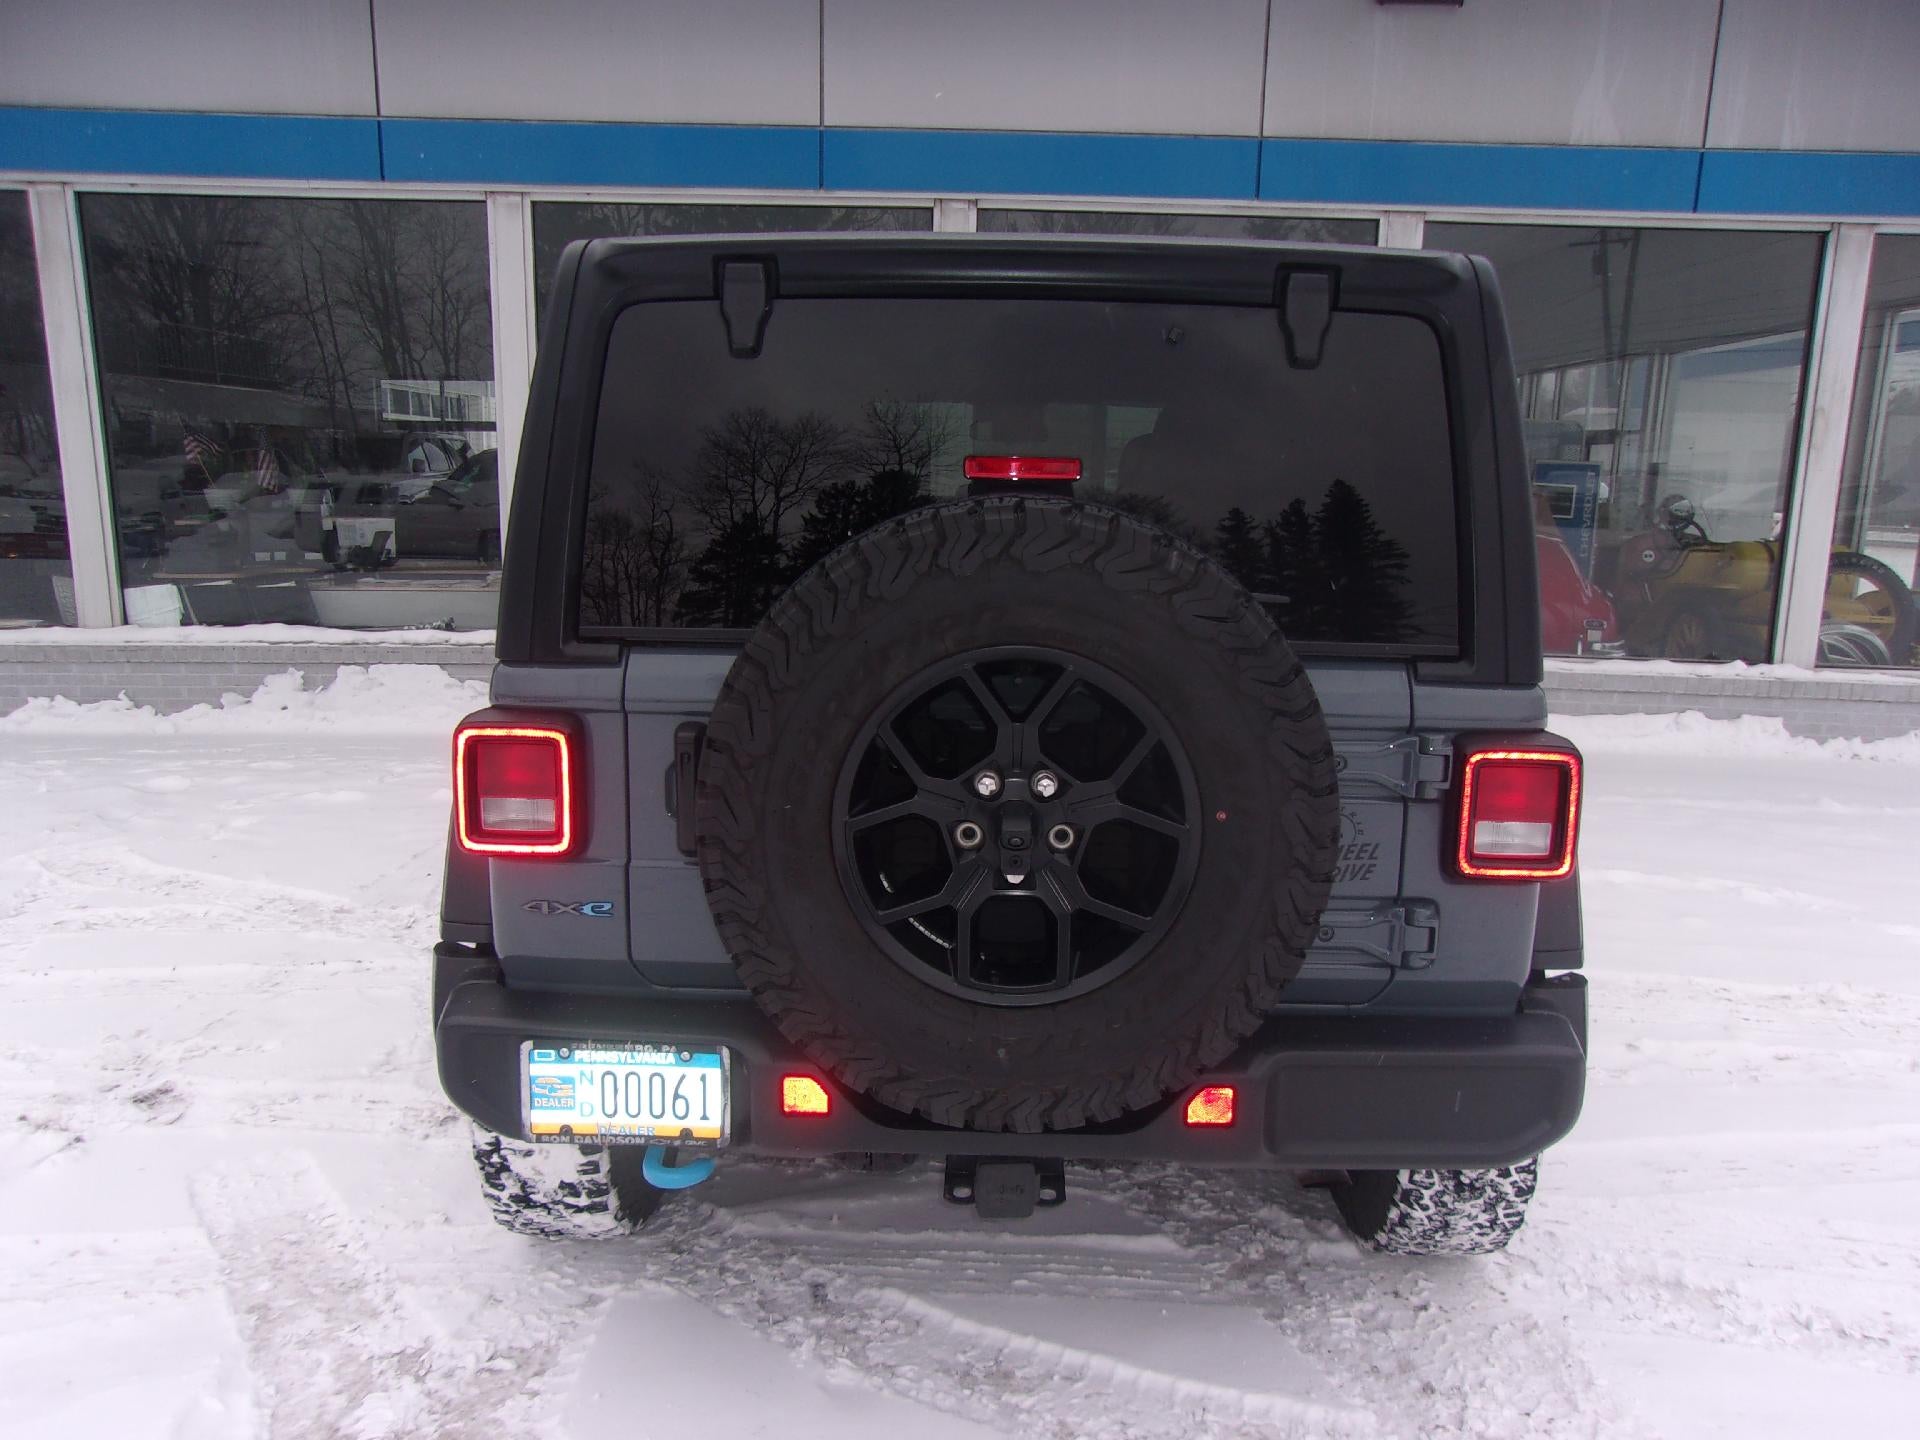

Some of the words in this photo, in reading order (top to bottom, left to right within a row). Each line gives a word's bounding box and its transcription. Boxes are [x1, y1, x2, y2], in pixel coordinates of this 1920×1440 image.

[574, 1050, 676, 1065] PENNSYLVANIA
[600, 1070, 710, 1121] 00061
[534, 1097, 574, 1108] DEALER
[599, 1125, 656, 1137] DEALER
[573, 1135, 646, 1146] DAVIDSON
